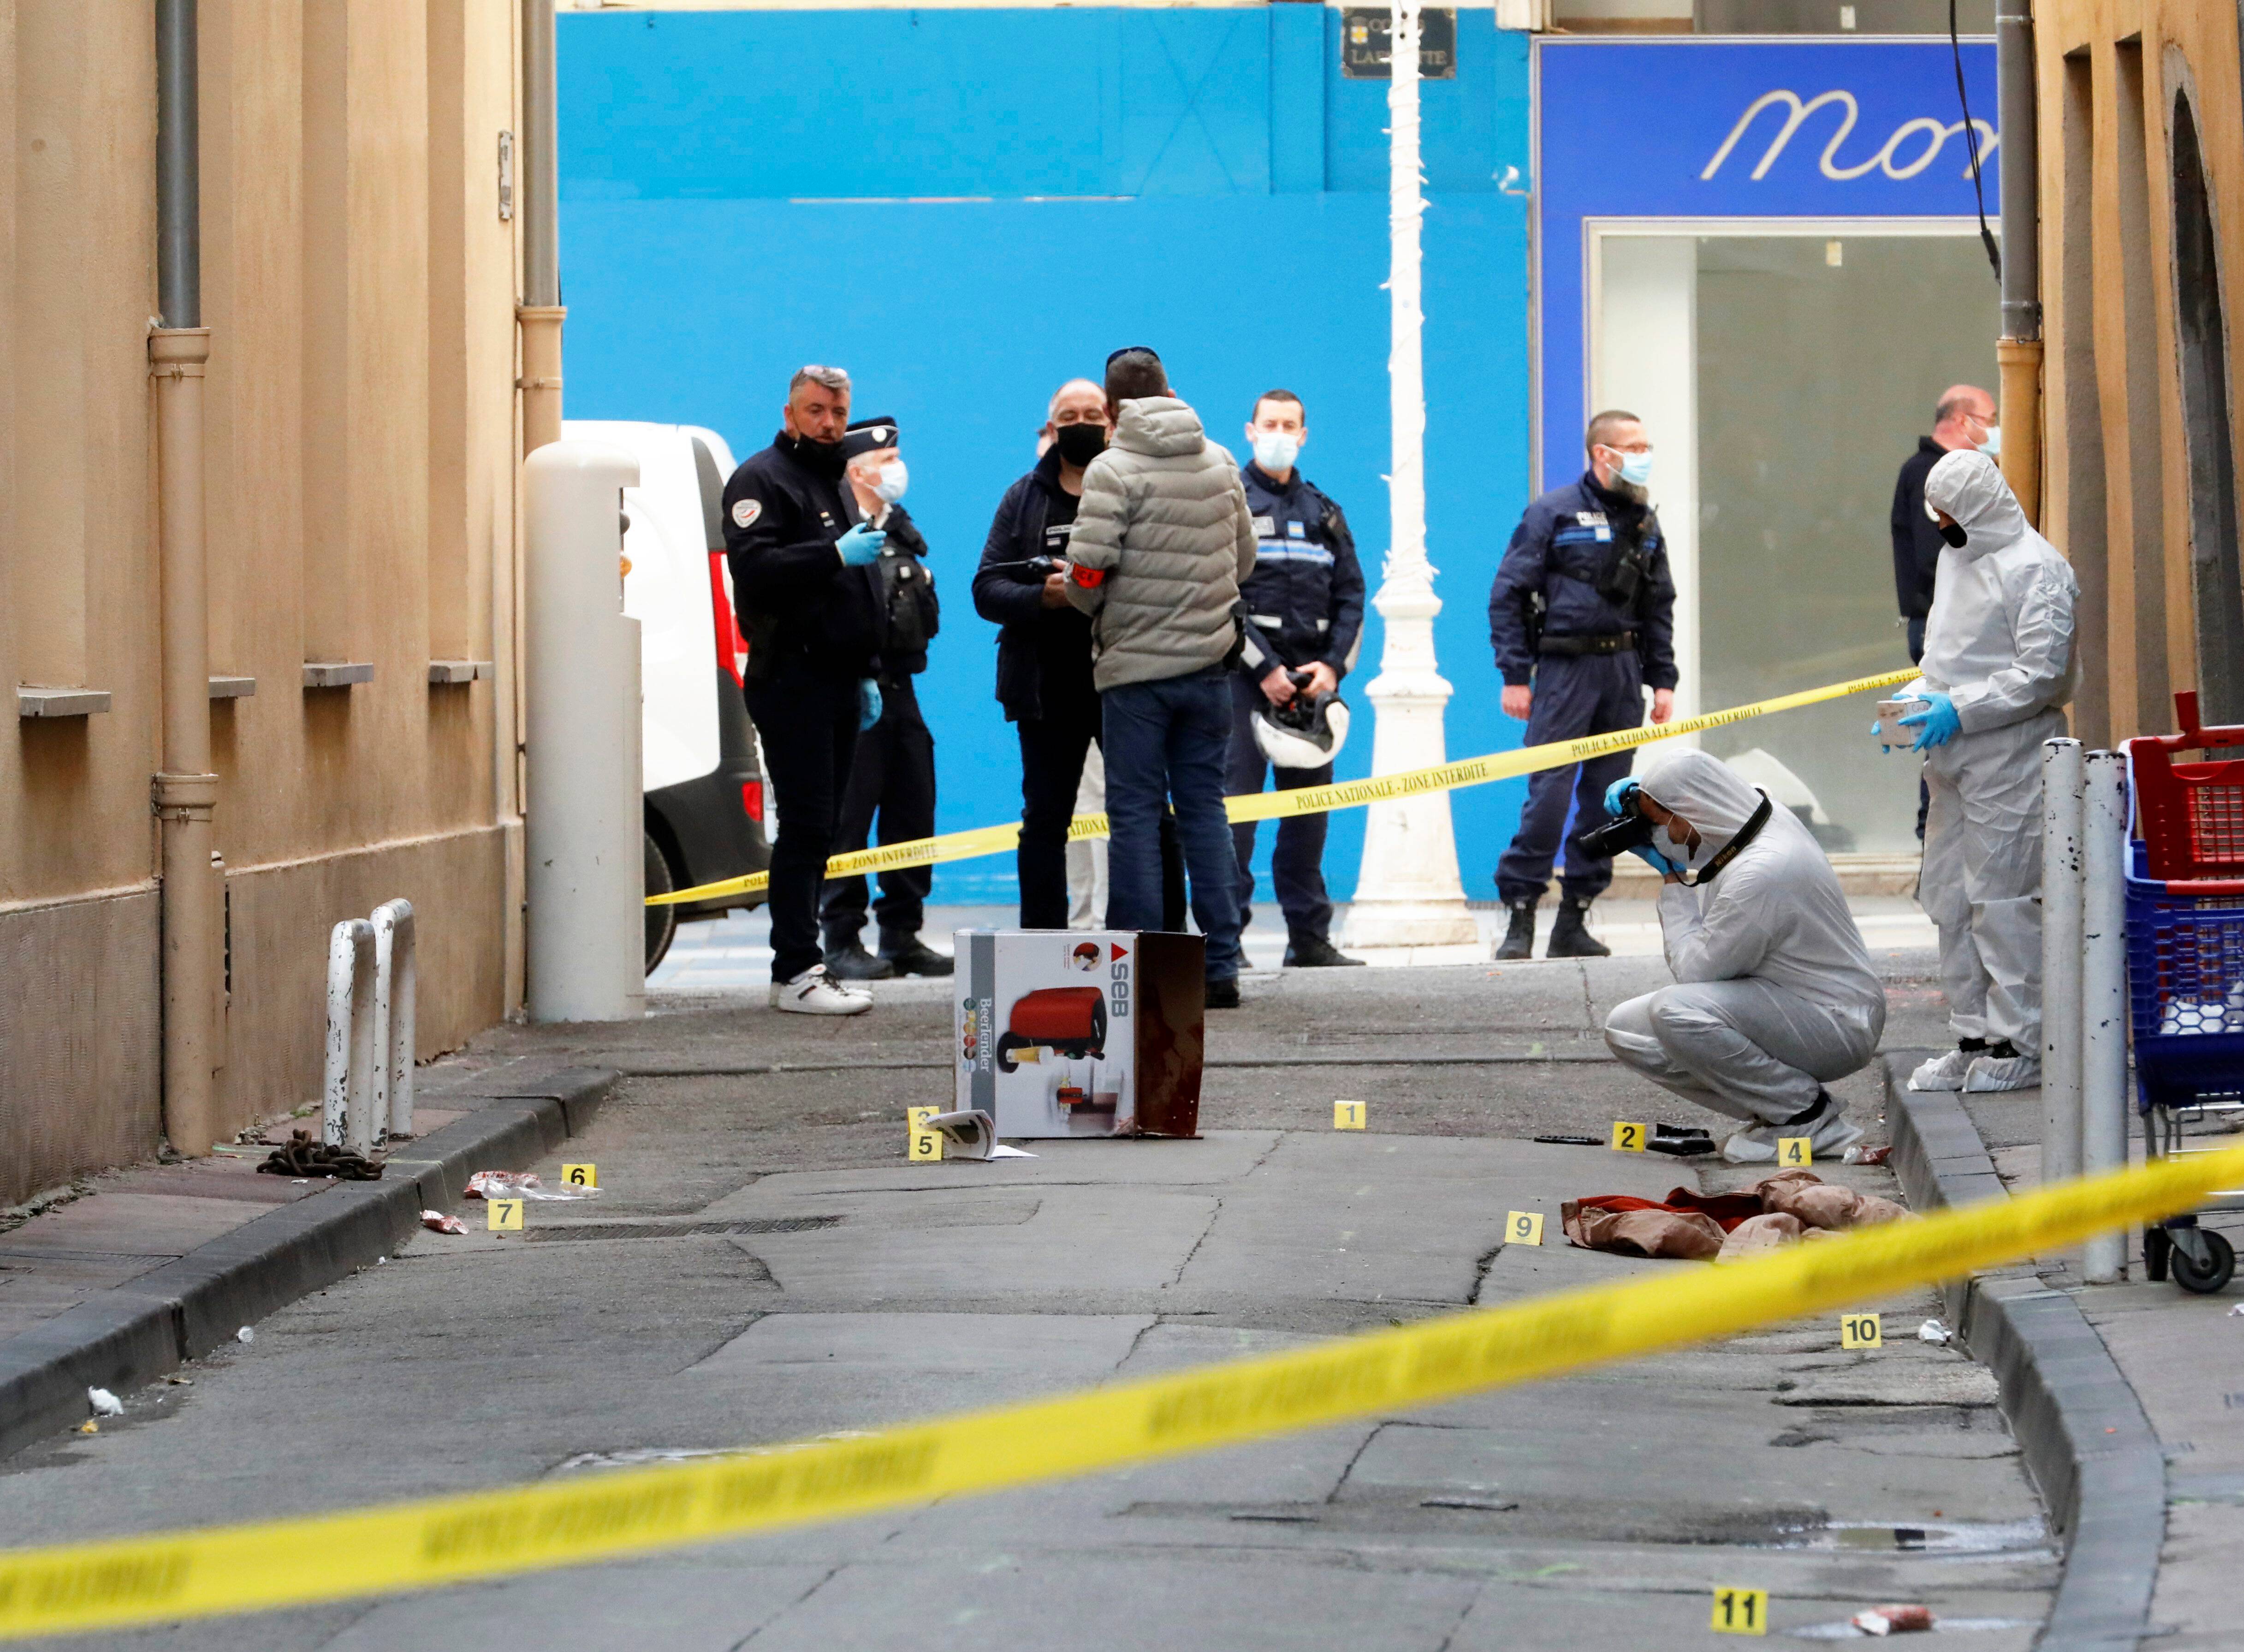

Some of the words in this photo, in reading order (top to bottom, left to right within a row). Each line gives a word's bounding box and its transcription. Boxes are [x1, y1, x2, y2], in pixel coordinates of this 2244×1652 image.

[1572, 739, 1609, 757] POLICE
[1614, 726, 1669, 747] NATIONALE
[1680, 719, 1706, 733] ZONE
[1710, 706, 1763, 727] INTERDITE
[1296, 790, 1335, 809] POLICE
[1336, 780, 1394, 803] NATIONALE
[1402, 773, 1430, 793] ZONE
[1432, 762, 1489, 787] INTERDITE
[853, 853, 880, 869] ZONE
[881, 843, 938, 864] INTERDITE
[1346, 1105, 1354, 1123] 1
[918, 1136, 932, 1154] 5
[1621, 1126, 1635, 1148] 2
[1788, 1141, 1802, 1163] 4
[570, 1168, 585, 1185] 6
[497, 1204, 513, 1224] 7
[1516, 1216, 1532, 1237] 9
[1846, 1319, 1876, 1341] 10
[1722, 1592, 1755, 1627] 11
